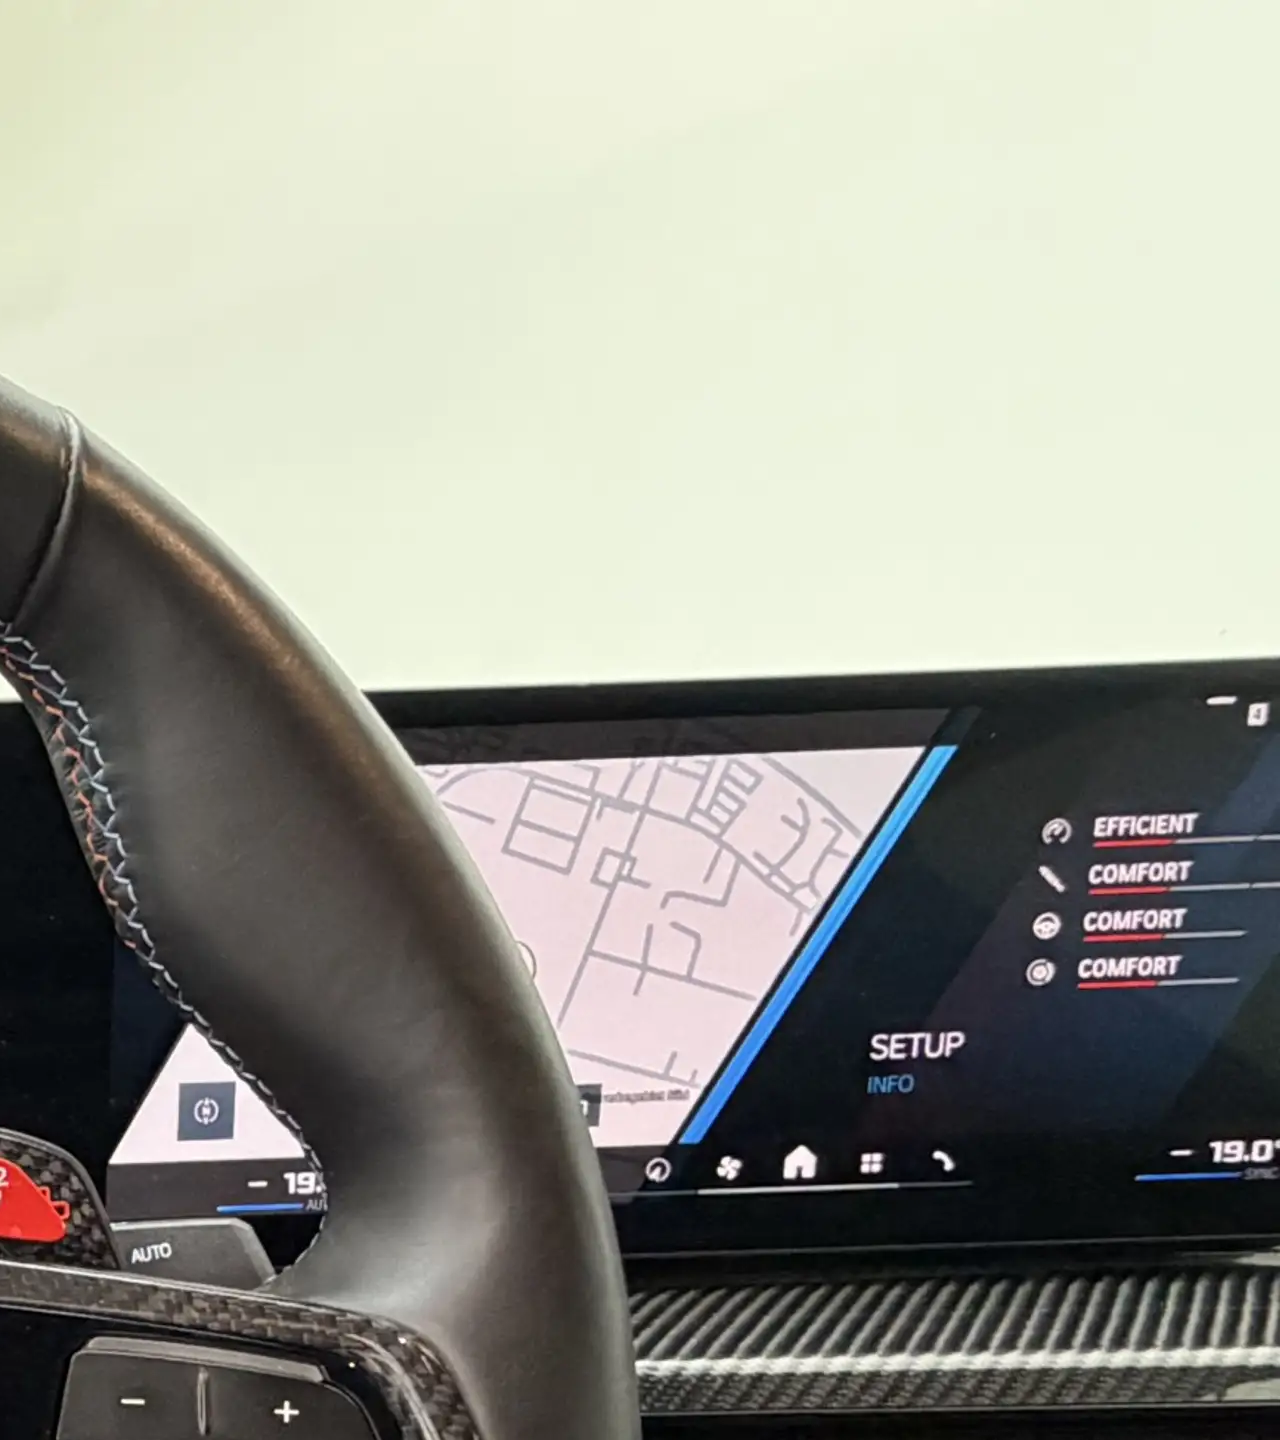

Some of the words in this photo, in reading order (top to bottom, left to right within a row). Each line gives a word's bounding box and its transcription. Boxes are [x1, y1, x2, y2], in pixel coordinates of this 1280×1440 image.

[1092, 812, 1200, 837] EFFICIENT
[1088, 860, 1194, 884] COMFORT
[1082, 907, 1188, 932] COMFORT
[1077, 954, 1183, 979] COMFORT
[869, 1031, 967, 1062] SETUP
[866, 1073, 916, 1095] INFO
[130, 1241, 173, 1265] AUTO
